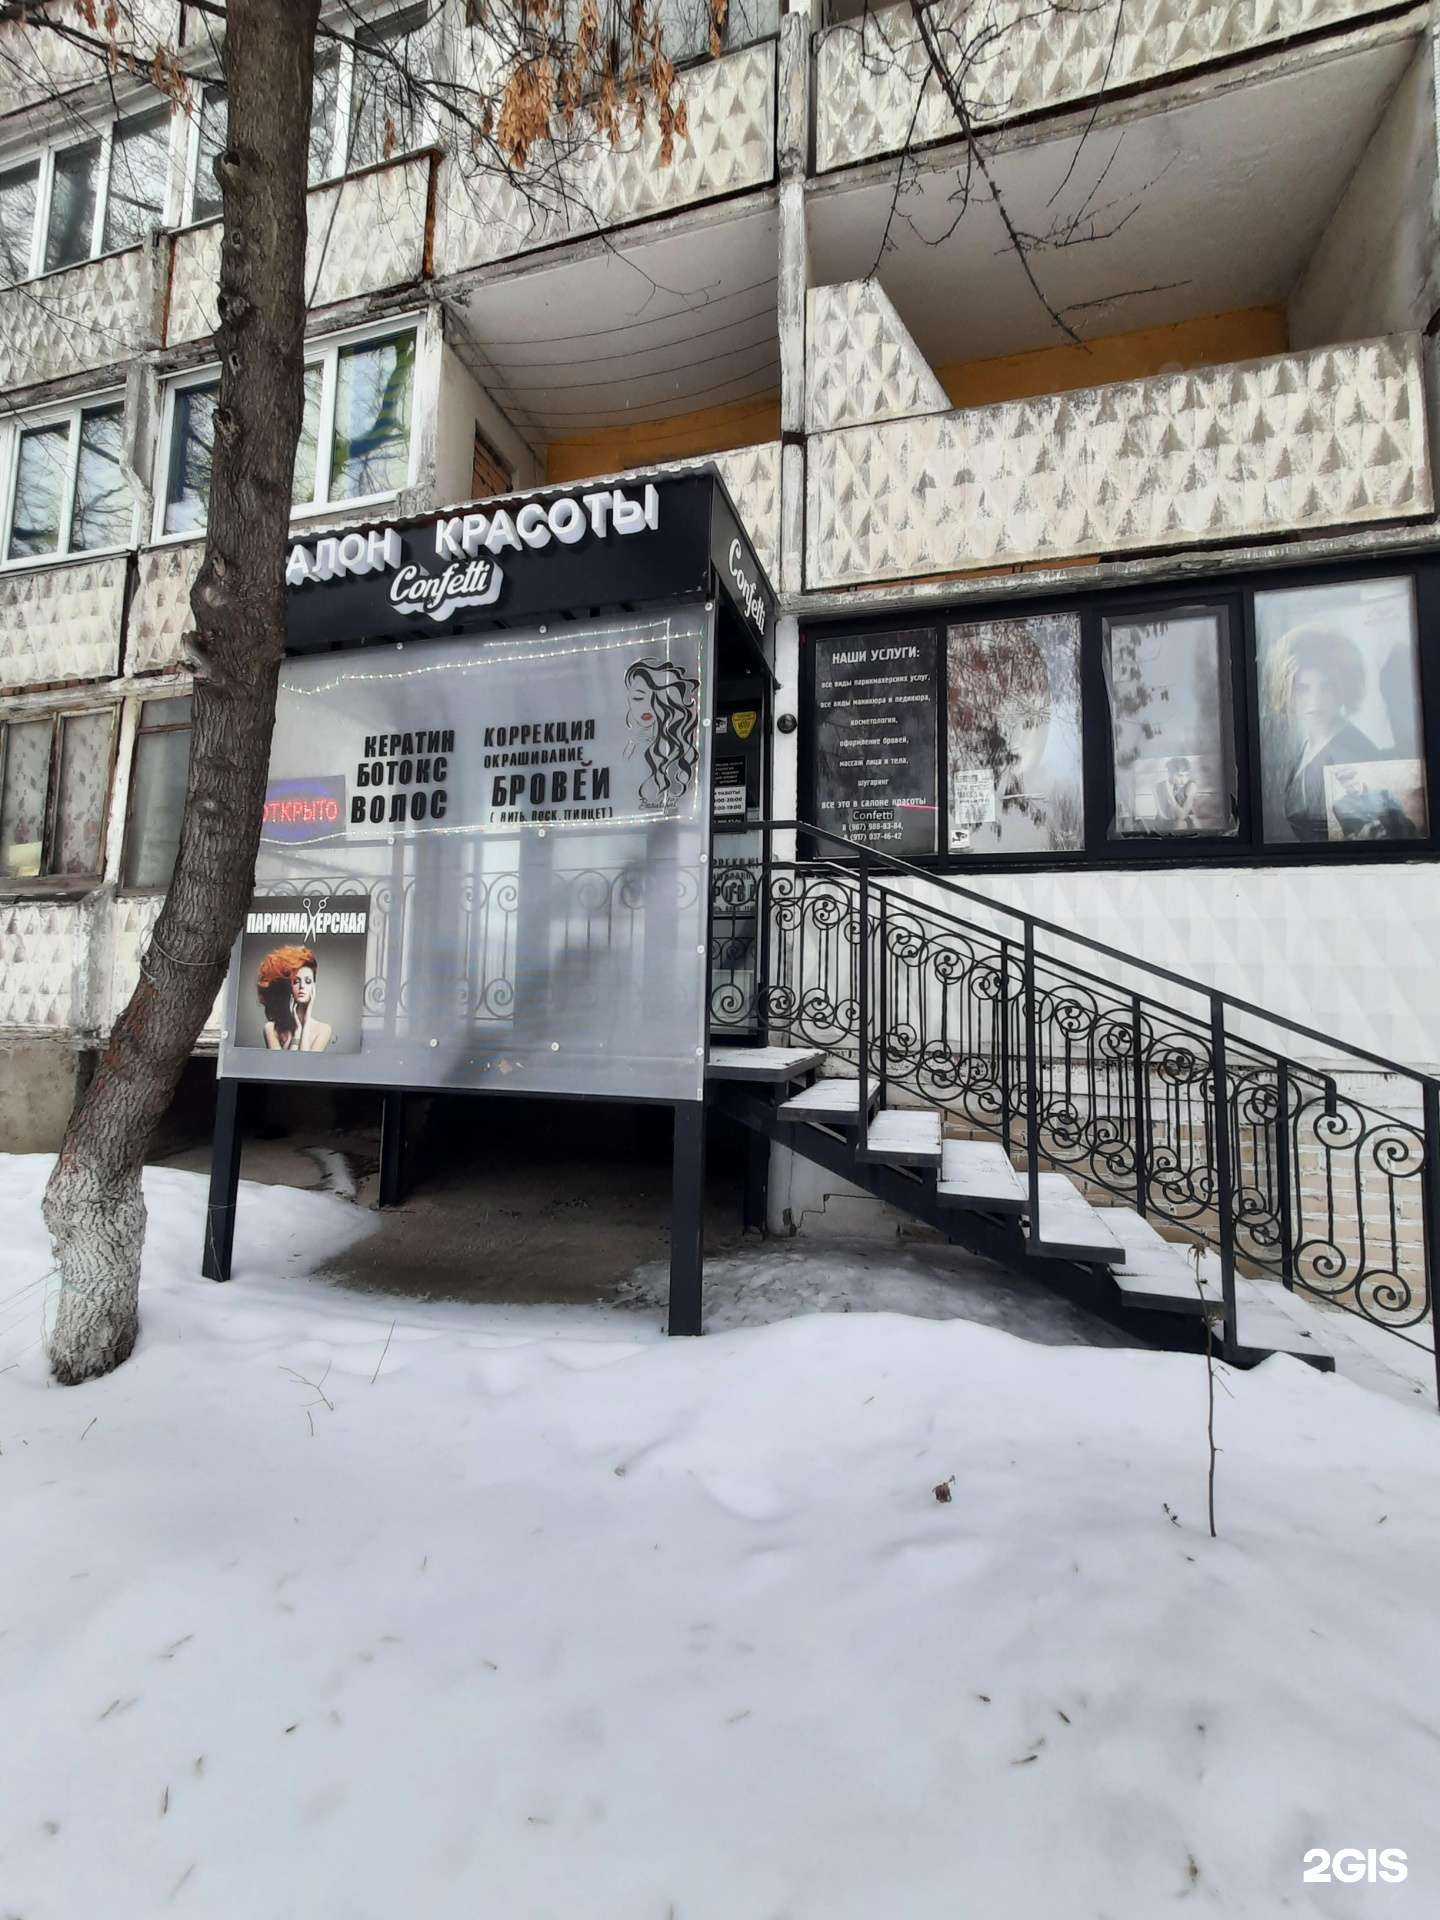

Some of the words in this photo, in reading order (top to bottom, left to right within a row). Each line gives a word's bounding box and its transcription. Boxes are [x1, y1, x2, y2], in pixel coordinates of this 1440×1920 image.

[286, 528, 401, 585] АЛОН
[435, 484, 659, 561] КРАСОТЫ
[389, 557, 494, 611] Confetti
[729, 538, 766, 636] Confetti
[832, 649, 867, 665] НАШИ
[871, 646, 920, 661] УСЛУГИ:
[821, 681, 833, 689] все
[834, 680, 852, 689] виды
[833, 699, 850, 708] виды
[852, 697, 886, 706] маникюра
[364, 729, 455, 757] КЕРАТИН
[484, 719, 595, 747] КОРРЕКЦИЯ
[839, 738, 881, 748] оформление
[484, 746, 584, 769] ОКРАШИВАНИЕ
[839, 759, 864, 767] массаж
[866, 758, 882, 766] лица
[357, 757, 448, 787] БОТОКС
[491, 760, 611, 807] БРОВЕЙ
[857, 778, 889, 787] шугаринг
[350, 790, 448, 824] ВОЛОС
[821, 801, 834, 809] все
[837, 801, 850, 809] это
[861, 799, 889, 807] салоне
[892, 797, 926, 806] красоты
[853, 811, 893, 820] Confetti
[246, 909, 367, 937] ПАРИКМАХЕРСКАЯ
